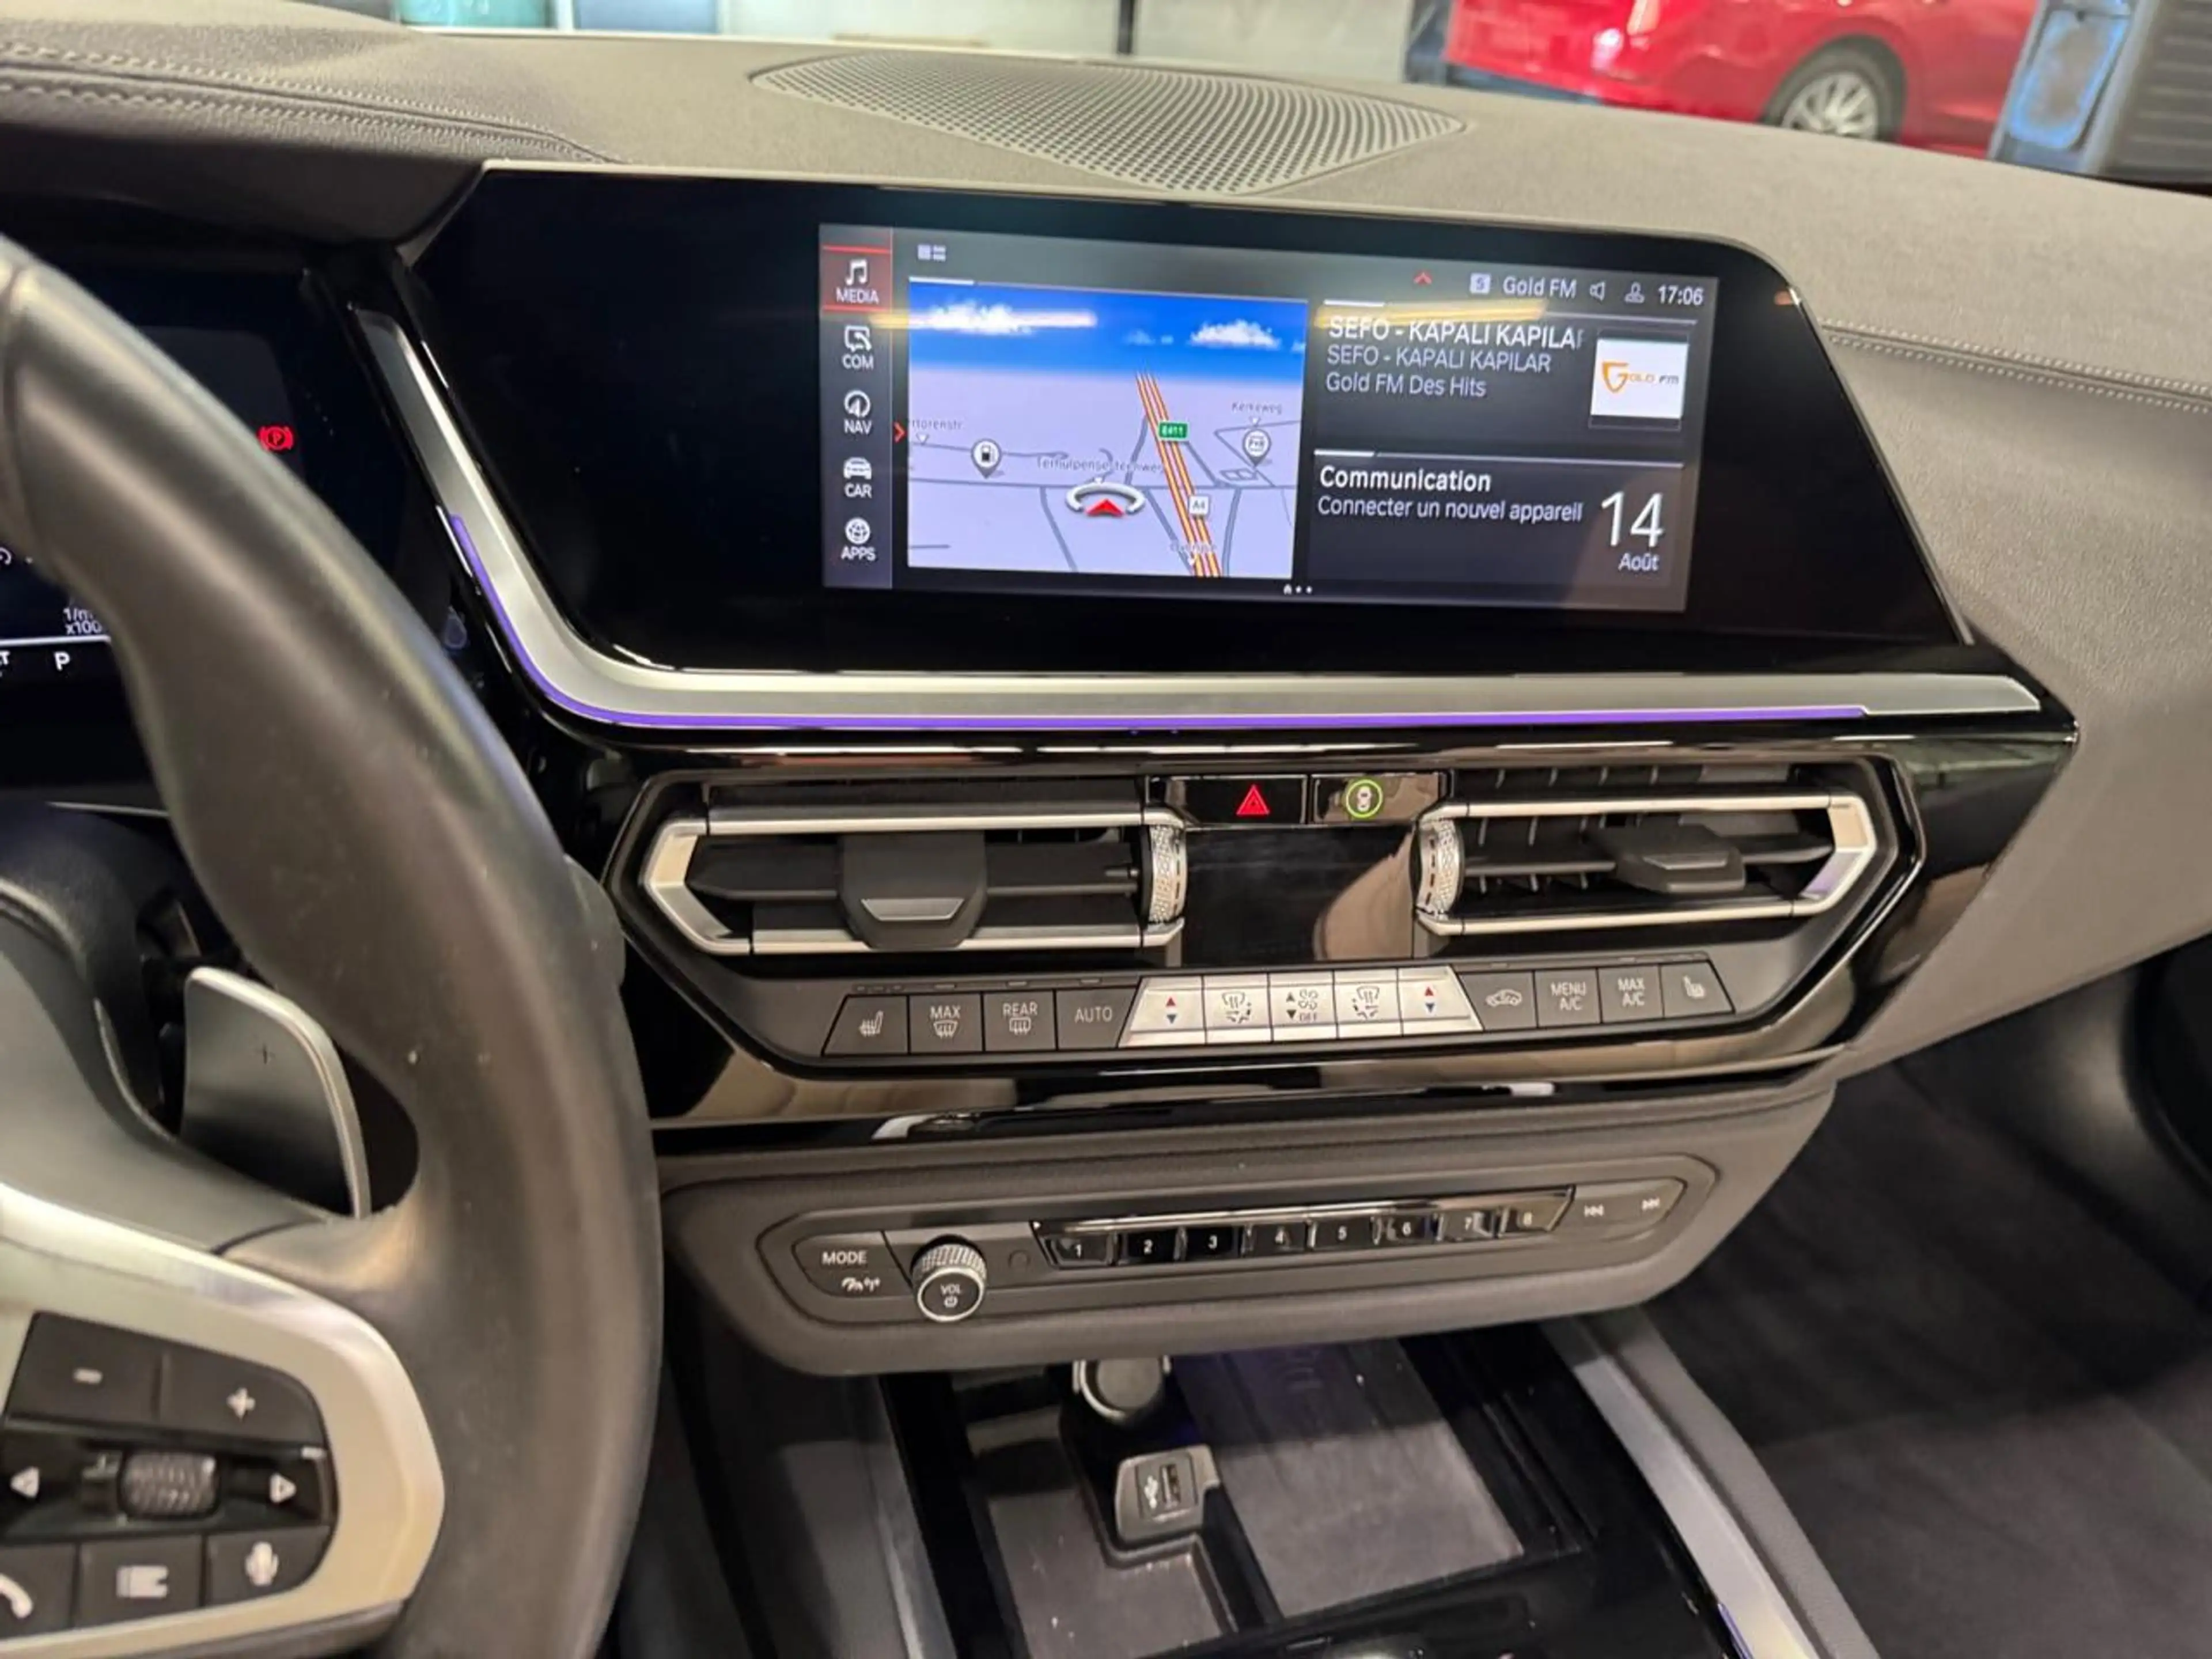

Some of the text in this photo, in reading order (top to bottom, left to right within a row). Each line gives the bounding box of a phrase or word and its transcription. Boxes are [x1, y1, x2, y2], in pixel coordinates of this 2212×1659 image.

[1503, 275, 1577, 299] Gold FM
[1658, 284, 1704, 306] 17:06
[836, 286, 880, 305] MEDIA
[1329, 316, 1390, 341] SEFO
[1410, 320, 1490, 345] KAPALI
[842, 353, 874, 370] COM
[1327, 344, 1380, 367] SEFO
[1396, 346, 1464, 370] KAPALI
[1470, 348, 1552, 373] KAPILAR
[1326, 370, 1487, 398] Gold FM Des Hits
[844, 419, 872, 434] NAV
[1320, 465, 1492, 492] Communication
[844, 483, 872, 498] CAR
[1192, 500, 1206, 511] A4
[1318, 495, 1583, 524] Connecter un nouvel appareil
[1601, 491, 1665, 547] 14
[840, 546, 876, 561] APPS
[1618, 552, 1660, 571] Août
[54, 650, 70, 671] P
[1551, 982, 1587, 997] MENU
[1618, 977, 1646, 992] MAX
[1560, 997, 1583, 1011] A/C
[1622, 992, 1645, 1007] A/C
[930, 1006, 961, 1020] MAX
[1003, 1002, 1038, 1017] REAR
[1075, 1007, 1113, 1023] AUTO
[1275, 1227, 1286, 1244] 4
[1338, 1225, 1347, 1241] 5
[1402, 1221, 1411, 1236] 6
[1144, 1239, 1153, 1254] 2
[1209, 1235, 1217, 1249] 3
[822, 1250, 867, 1266] MODE
[1075, 1244, 1082, 1257] 1
[941, 1284, 961, 1296] VOL
